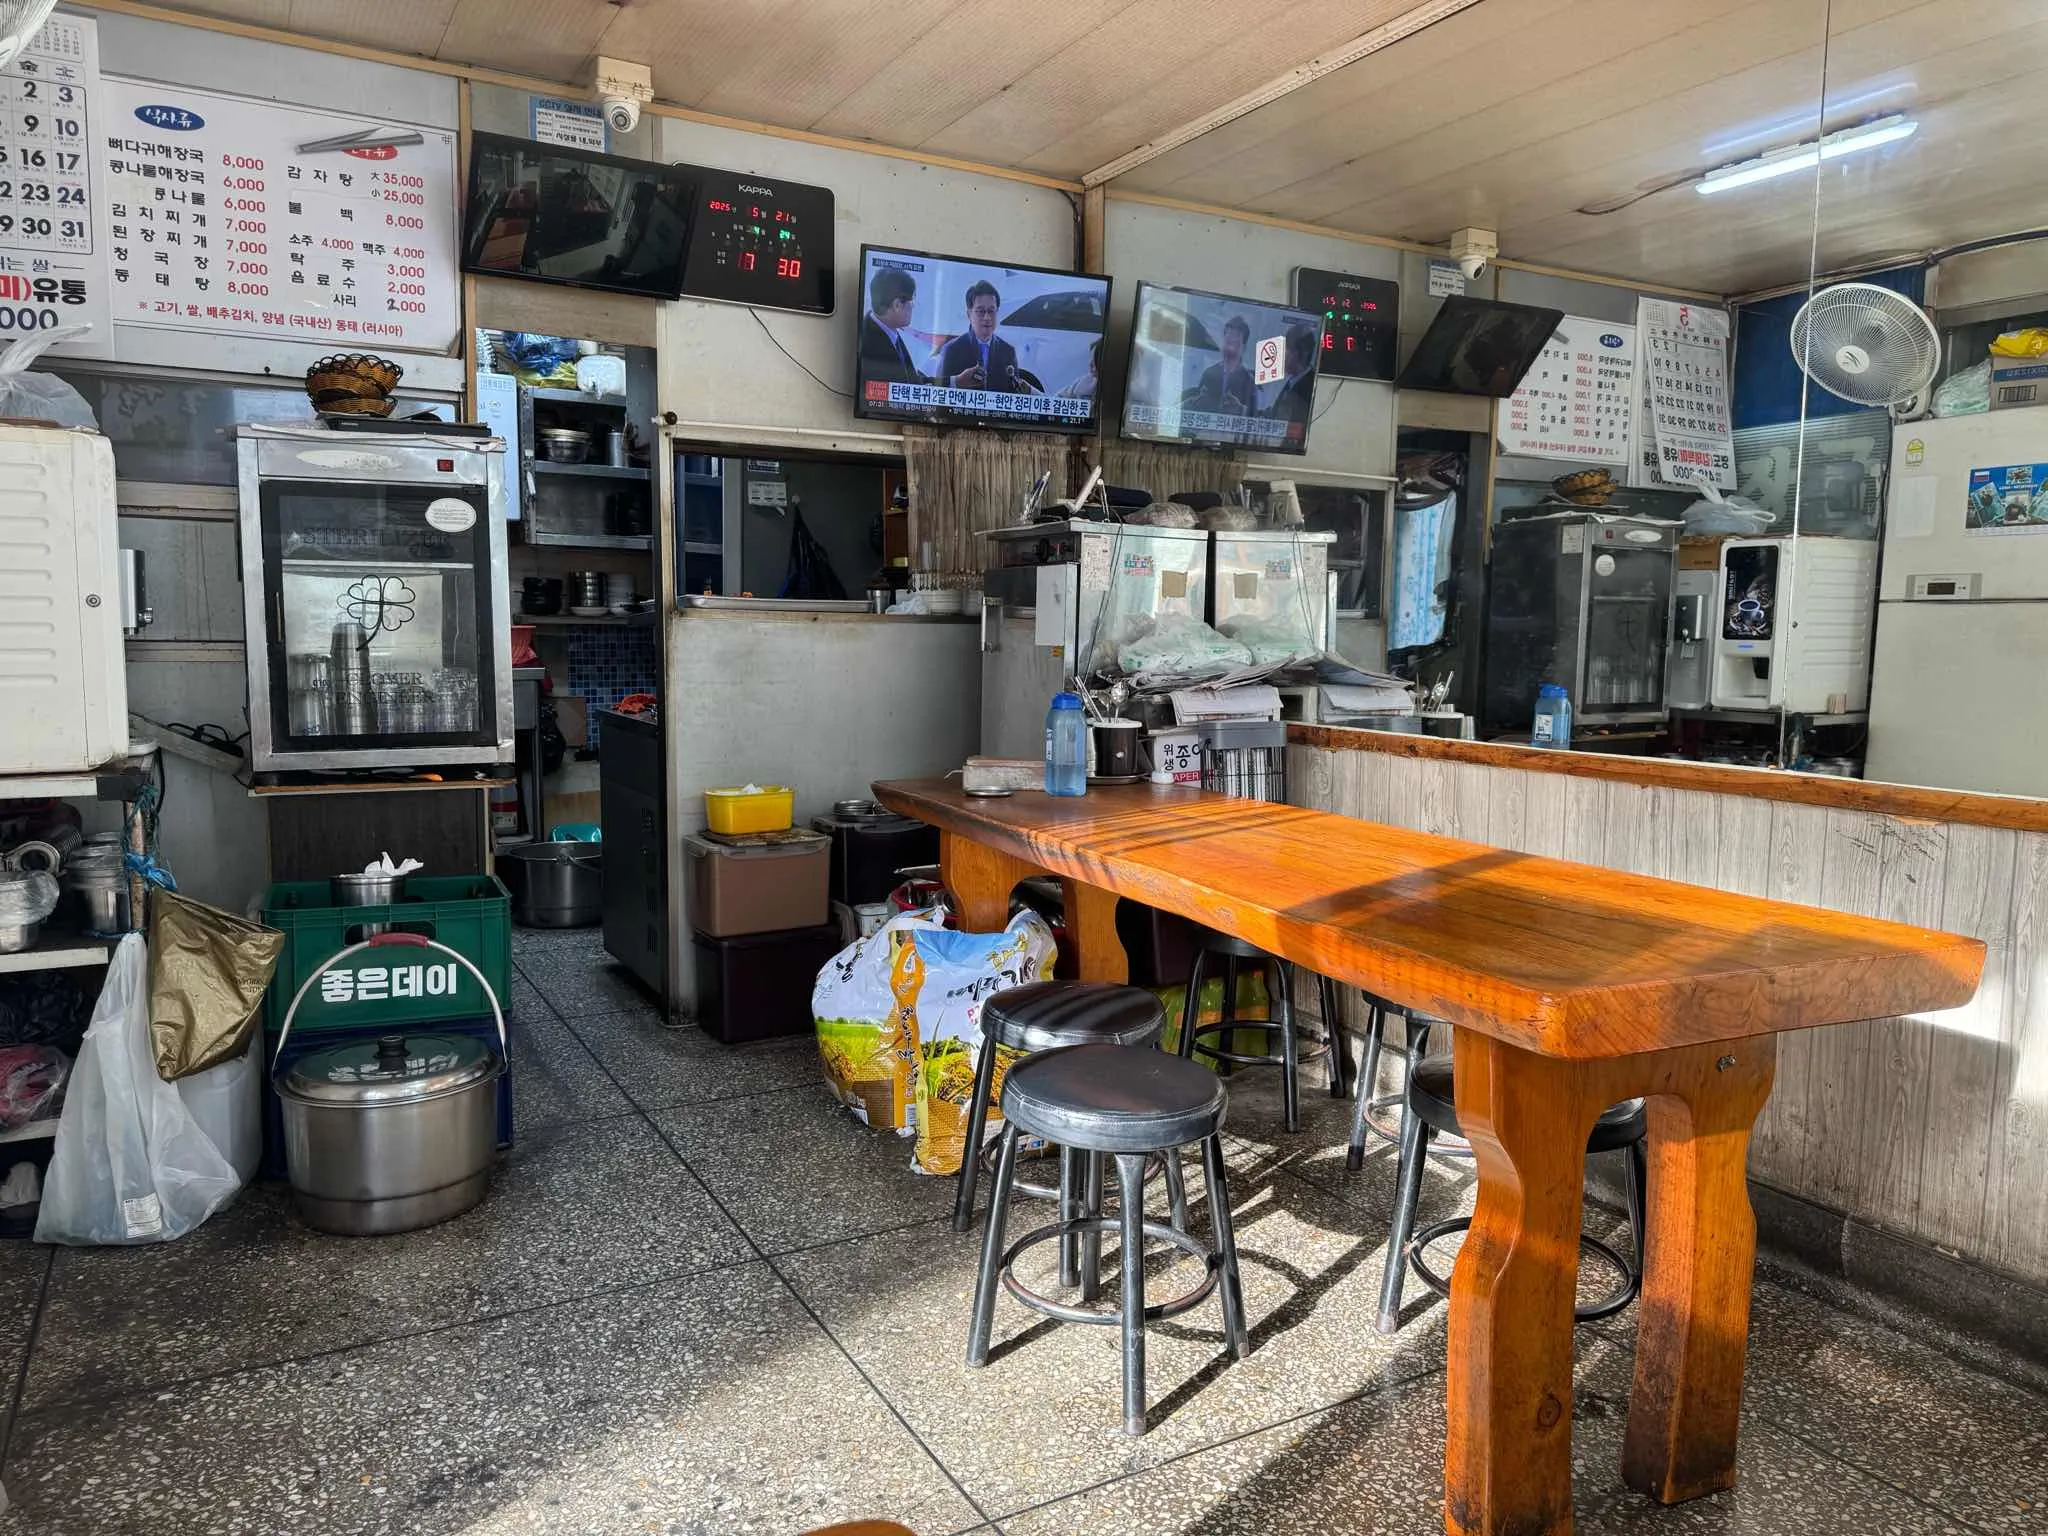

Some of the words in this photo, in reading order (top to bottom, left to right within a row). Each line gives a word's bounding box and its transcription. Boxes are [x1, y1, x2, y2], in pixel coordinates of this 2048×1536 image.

[24, 81, 38, 98] 2
[58, 86, 74, 103] 3
[24, 115, 39, 132] 9
[55, 118, 80, 137] 10
[145, 107, 193, 129] 식사류
[20, 148, 47, 168] 16
[56, 152, 81, 171] 17
[108, 136, 204, 164] 뼈다귀해장국
[222, 153, 264, 171] 8,000
[109, 159, 205, 185] 콩나물해장국
[223, 175, 266, 193] 6,000
[383, 172, 424, 189] 35,000
[21, 182, 51, 202] 23
[57, 186, 86, 205] 24
[383, 189, 425, 206] 25,000
[738, 184, 774, 198] KAPPA
[224, 197, 266, 213] 6,000
[709, 201, 731, 212] 2025
[752, 207, 760, 218] 5
[775, 211, 790, 222] 21
[22, 217, 52, 236] 30
[60, 220, 85, 239] 31
[111, 203, 207, 227] 김치찌개
[225, 217, 267, 234] 7,000
[385, 214, 424, 230] 8,000
[112, 224, 208, 249] 된장찌개
[226, 239, 268, 255] 7,000
[289, 233, 314, 247] 소주
[362, 242, 387, 256] 맥주
[393, 247, 425, 260] 4,000
[113, 246, 209, 271] 청국장
[227, 260, 269, 276] 7,000
[387, 263, 425, 279] 3,000
[745, 252, 755, 271] 7
[777, 258, 801, 278] 30
[114, 268, 210, 292] 동태탕
[227, 281, 269, 297] 8,000
[387, 281, 426, 296] 2,000
[332, 294, 358, 308] 사리
[335, 319, 358, 333] 동태
[891, 385, 911, 402] 탄핵
[911, 387, 931, 403] 복귀
[932, 388, 947, 405] 2달
[948, 390, 967, 406] 만에
[1015, 396, 1032, 411] 정리
[1033, 398, 1051, 413] 이후
[1052, 399, 1079, 416] 결심한
[1079, 402, 1090, 416] 듯
[1163, 743, 1175, 771] 위생
[320, 962, 458, 1003] 좋은데이
